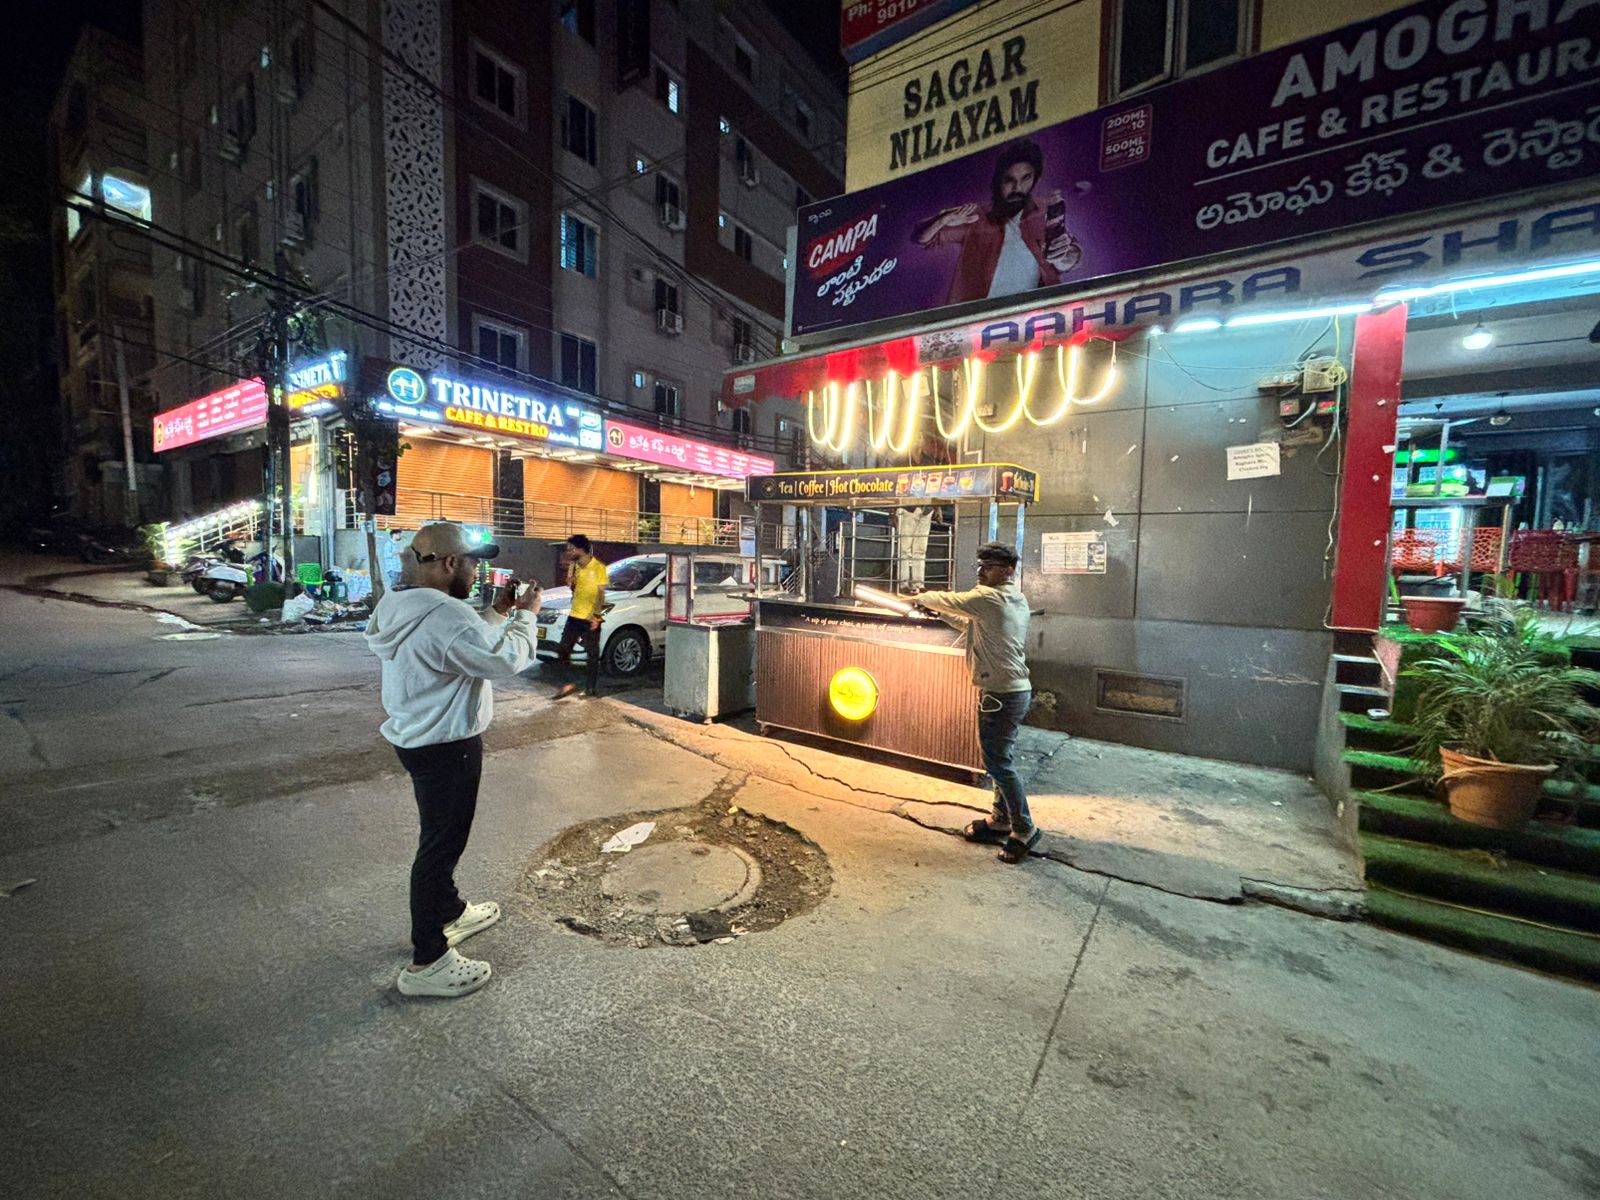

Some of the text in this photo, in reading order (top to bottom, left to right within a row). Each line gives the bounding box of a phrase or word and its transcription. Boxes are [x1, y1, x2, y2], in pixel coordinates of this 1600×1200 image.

[903, 35, 1027, 119] SAGAR
[889, 79, 1039, 171] NILAYAM
[1107, 109, 1148, 129] 200ML
[1206, 37, 1600, 169] CAFE & RESTAUR
[1105, 136, 1145, 155] 500ML
[1421, 143, 1465, 179] &
[809, 213, 878, 269] CAMPA
[980, 266, 1302, 349] AAHARA
[431, 376, 564, 427] TRINETRA
[445, 406, 485, 426] CAFE
[485, 413, 498, 428] &
[498, 415, 549, 438] RESTRO
[778, 481, 793, 494] Tea
[799, 479, 824, 497] Coffee
[829, 477, 849, 496] Hot
[850, 477, 894, 495] Chocolate
